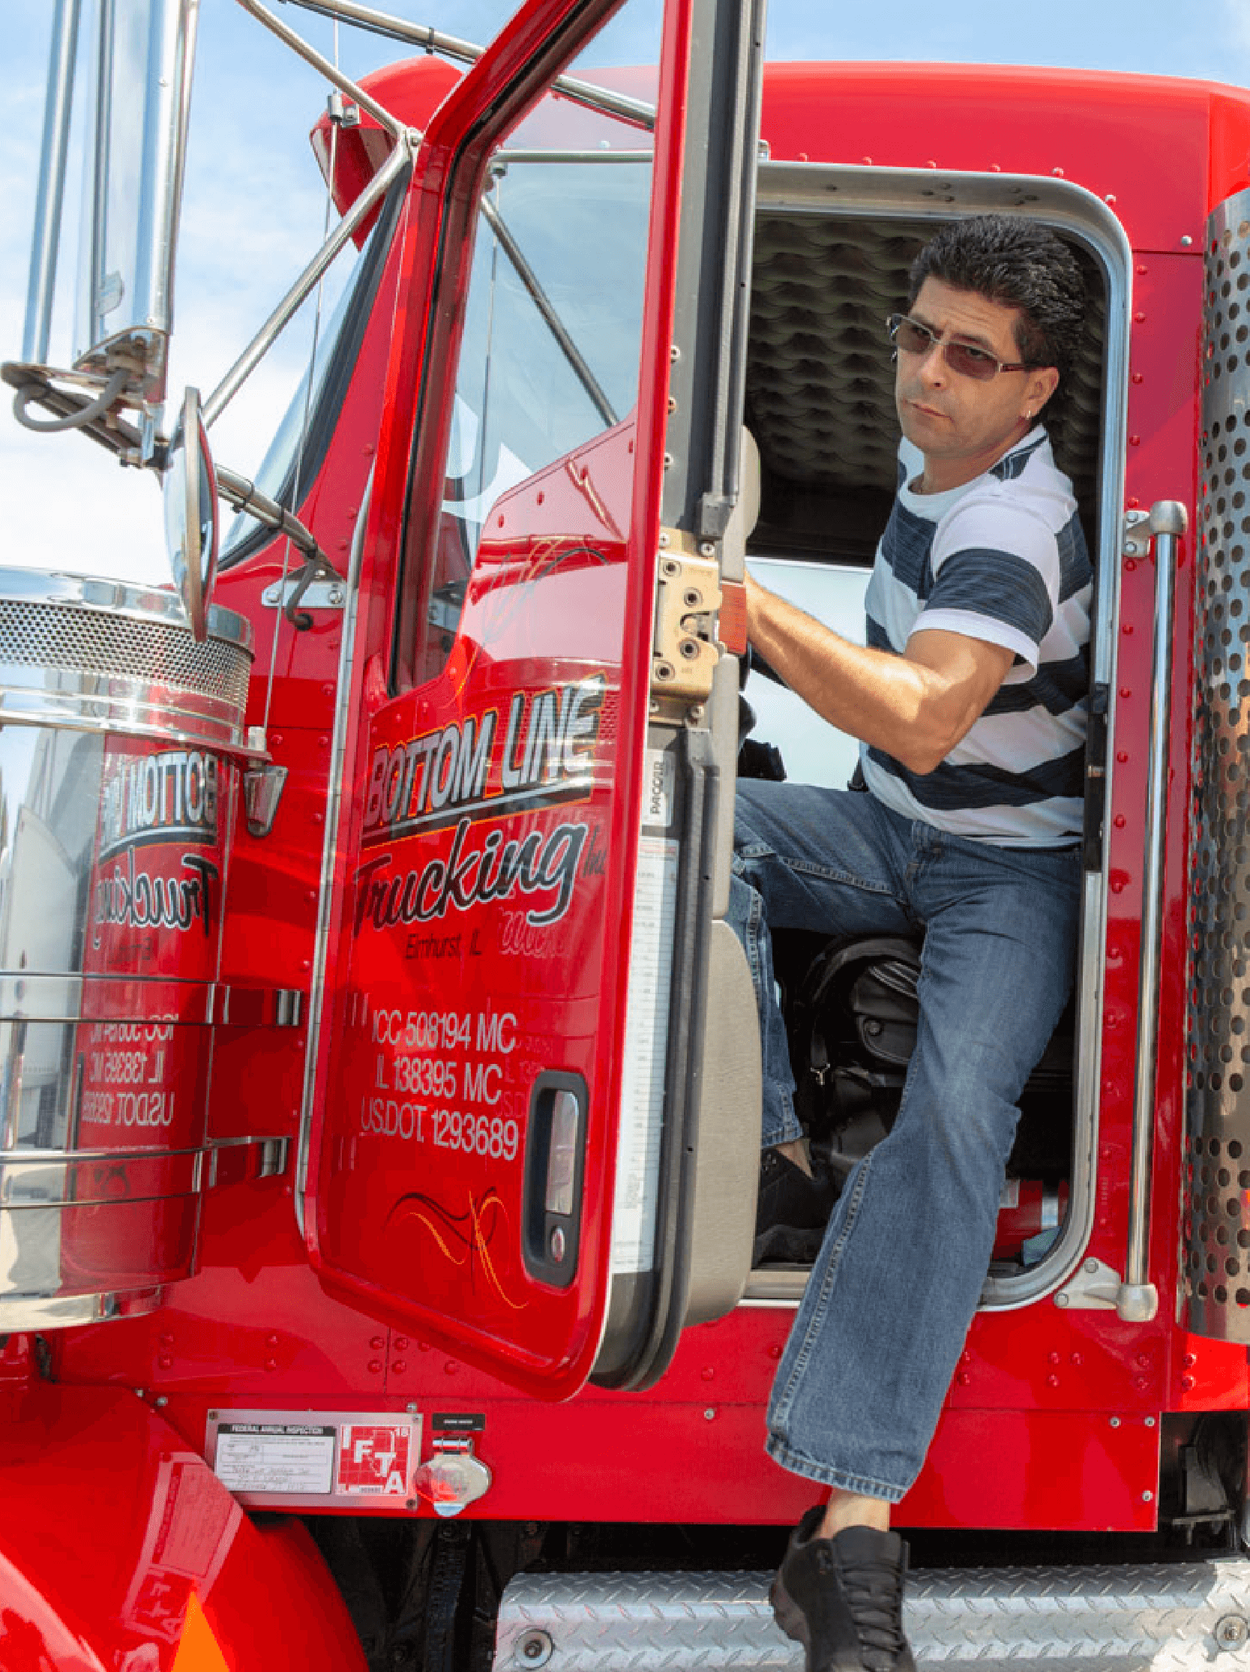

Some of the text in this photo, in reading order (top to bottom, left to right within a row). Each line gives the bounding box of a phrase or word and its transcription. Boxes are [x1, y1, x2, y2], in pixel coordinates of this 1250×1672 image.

[363, 671, 606, 828] BOTTOM LINE
[353, 817, 589, 939] Trucking
[372, 1009, 519, 1054] ICC 508194 MC
[374, 1053, 390, 1090] IL
[392, 1056, 458, 1100] 138395
[463, 1062, 503, 1105] MC
[431, 1110, 520, 1161] 1293689
